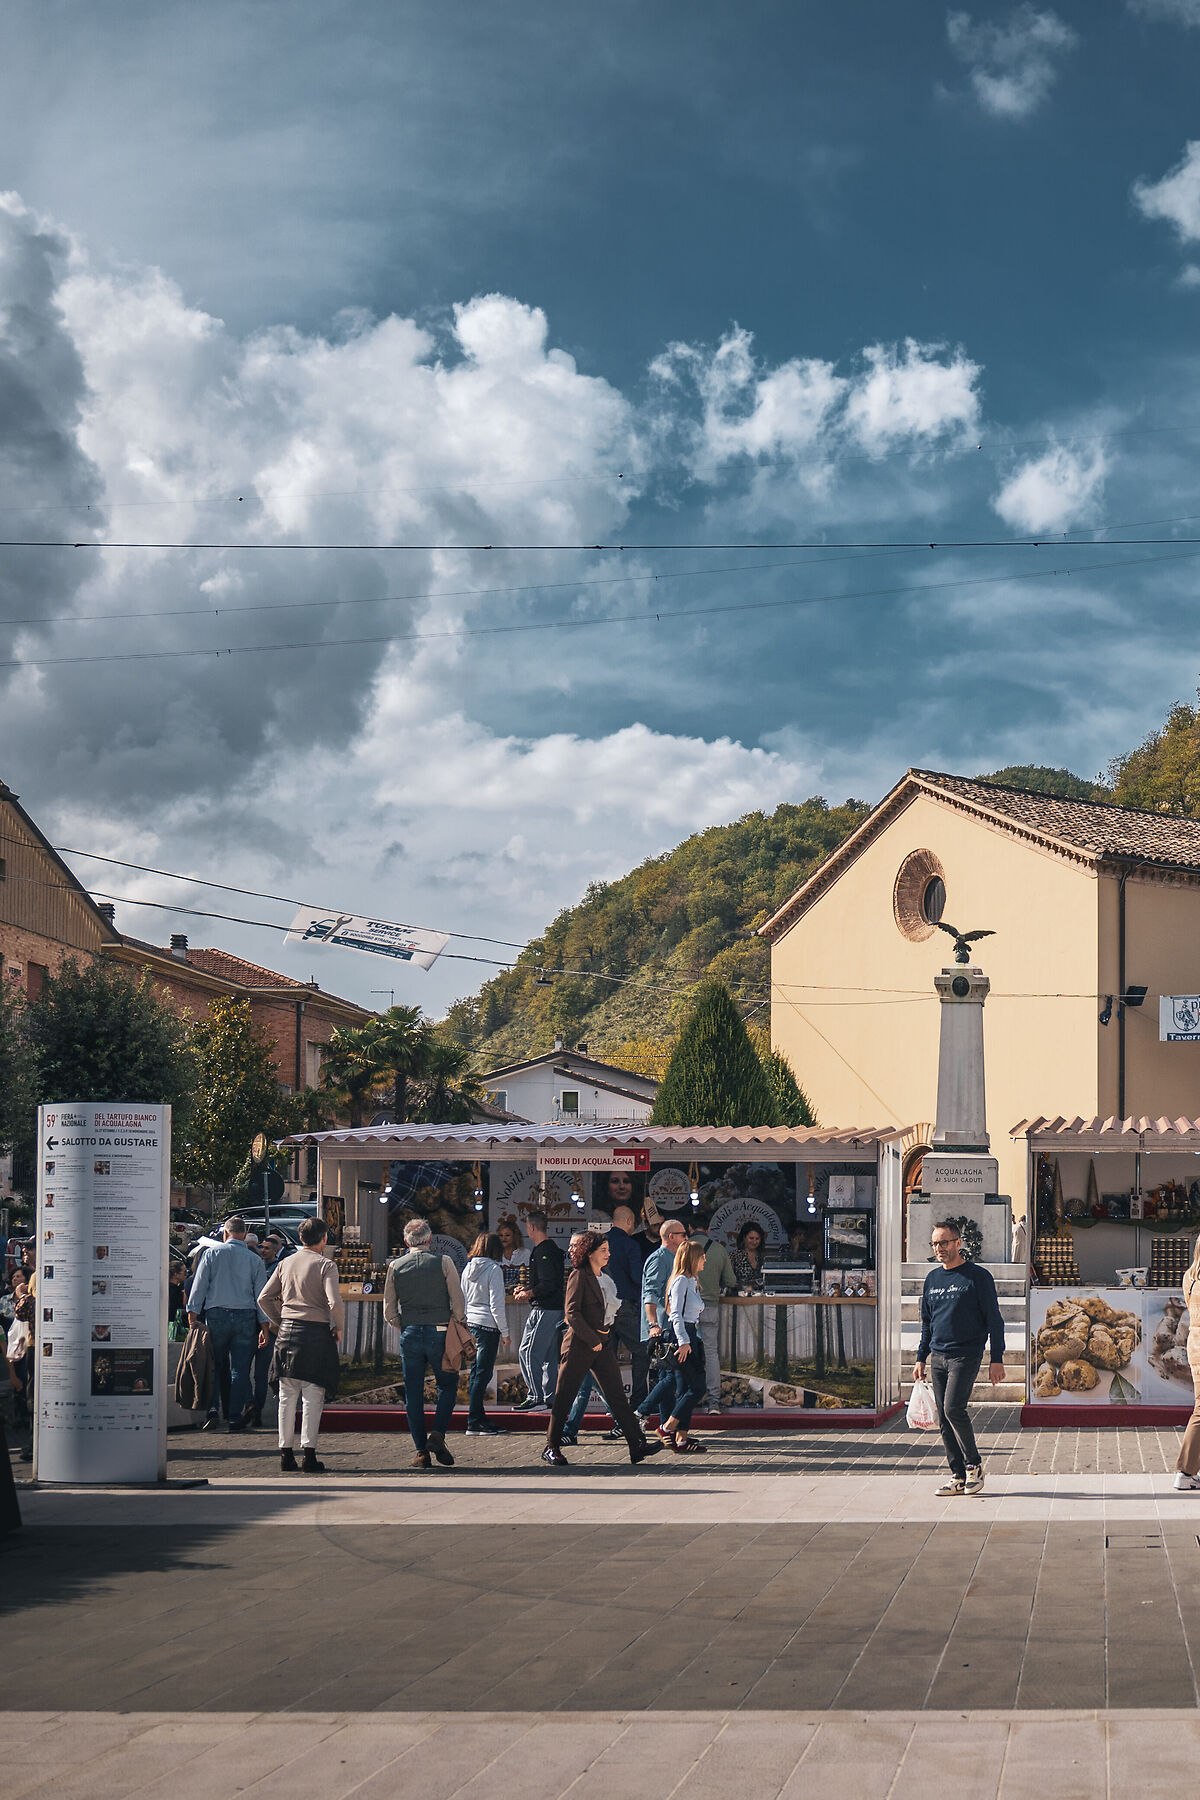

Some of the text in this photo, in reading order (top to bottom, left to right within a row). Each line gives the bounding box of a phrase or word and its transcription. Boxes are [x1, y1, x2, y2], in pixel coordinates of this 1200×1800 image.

[368, 928, 401, 937] SERVICE
[61, 1137, 158, 1147] SALOTTO DA GUSTARE
[539, 1157, 633, 1166] I NOBILI DI ACQUALAGNA
[935, 1168, 982, 1176] ACQUALAGNA
[496, 1169, 525, 1201] Nobili
[526, 1166, 534, 1176] di
[710, 1205, 733, 1231] Nobili
[741, 1200, 780, 1241] Acqualagna
